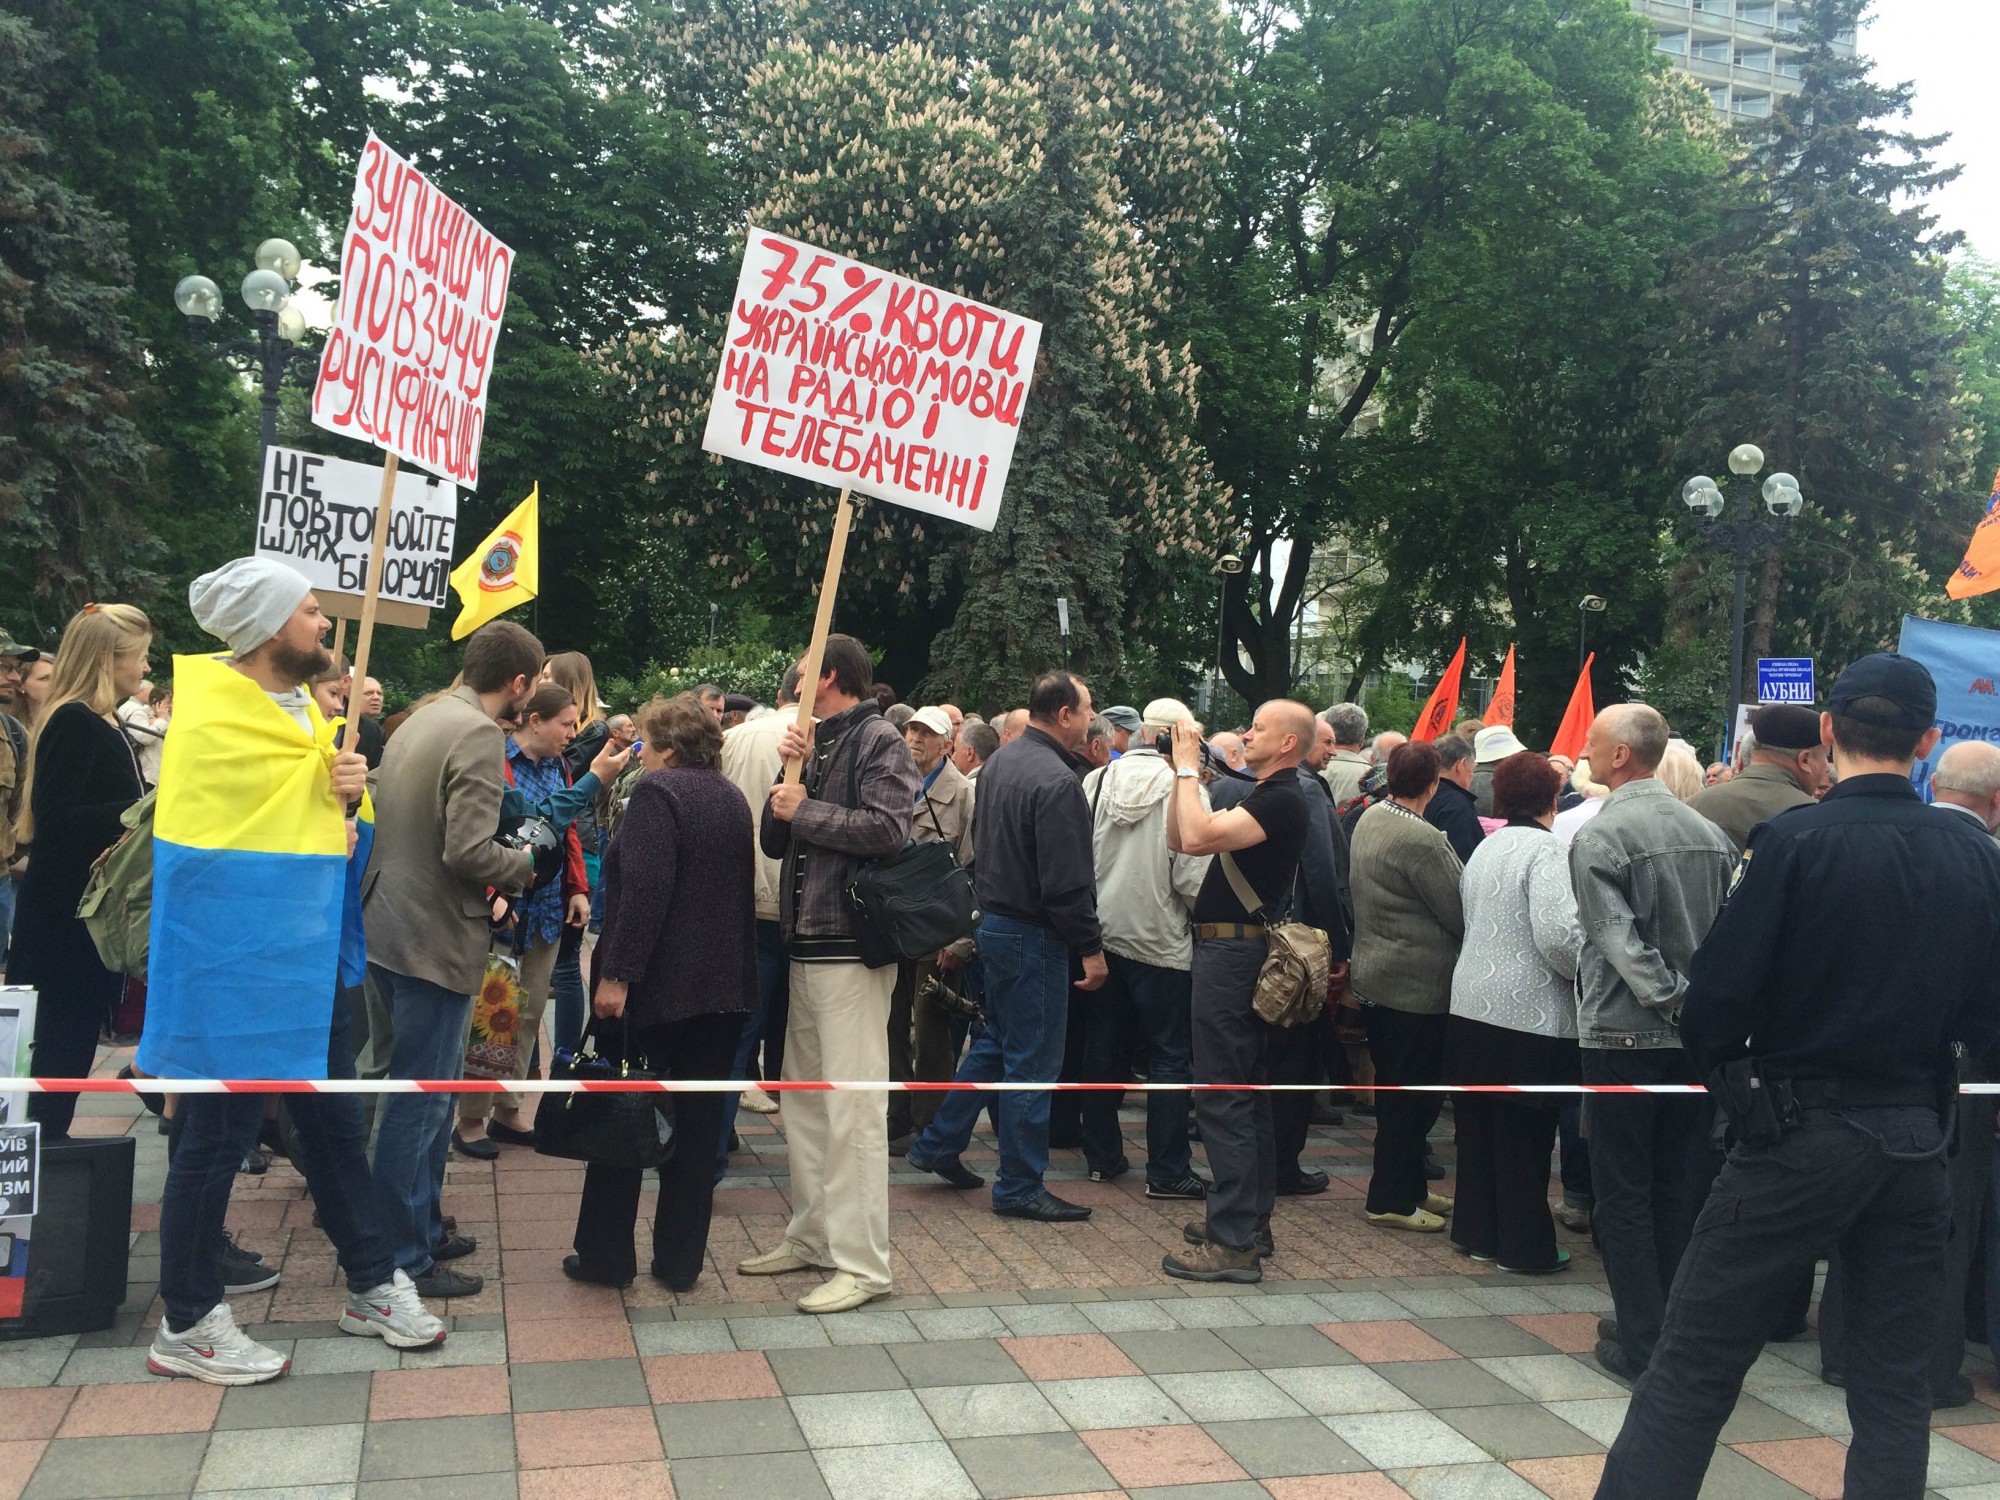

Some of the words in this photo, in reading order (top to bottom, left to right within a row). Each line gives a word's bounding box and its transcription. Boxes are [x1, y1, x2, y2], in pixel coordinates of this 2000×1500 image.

[355, 140, 509, 321] ЗУПИНИМО
[341, 233, 493, 399] ПОВЗУЧУ
[732, 298, 919, 389] УКРАЇНСЬКОЇ
[915, 356, 1025, 427] МОВИ
[760, 238, 883, 334] 75%
[880, 281, 1026, 377] КВОТИ
[314, 326, 483, 482] РУСИФІКАЦІЮ
[723, 348, 769, 403] НА
[787, 364, 915, 430] РАДІО
[272, 450, 325, 499] НЕ
[735, 399, 990, 511] ТЕЛЕБАЧЕННІ
[259, 525, 344, 565] ШЛЯХ
[1760, 681, 1812, 701] ЛУБНИ
[0, 1156, 29, 1175] ИЙ
